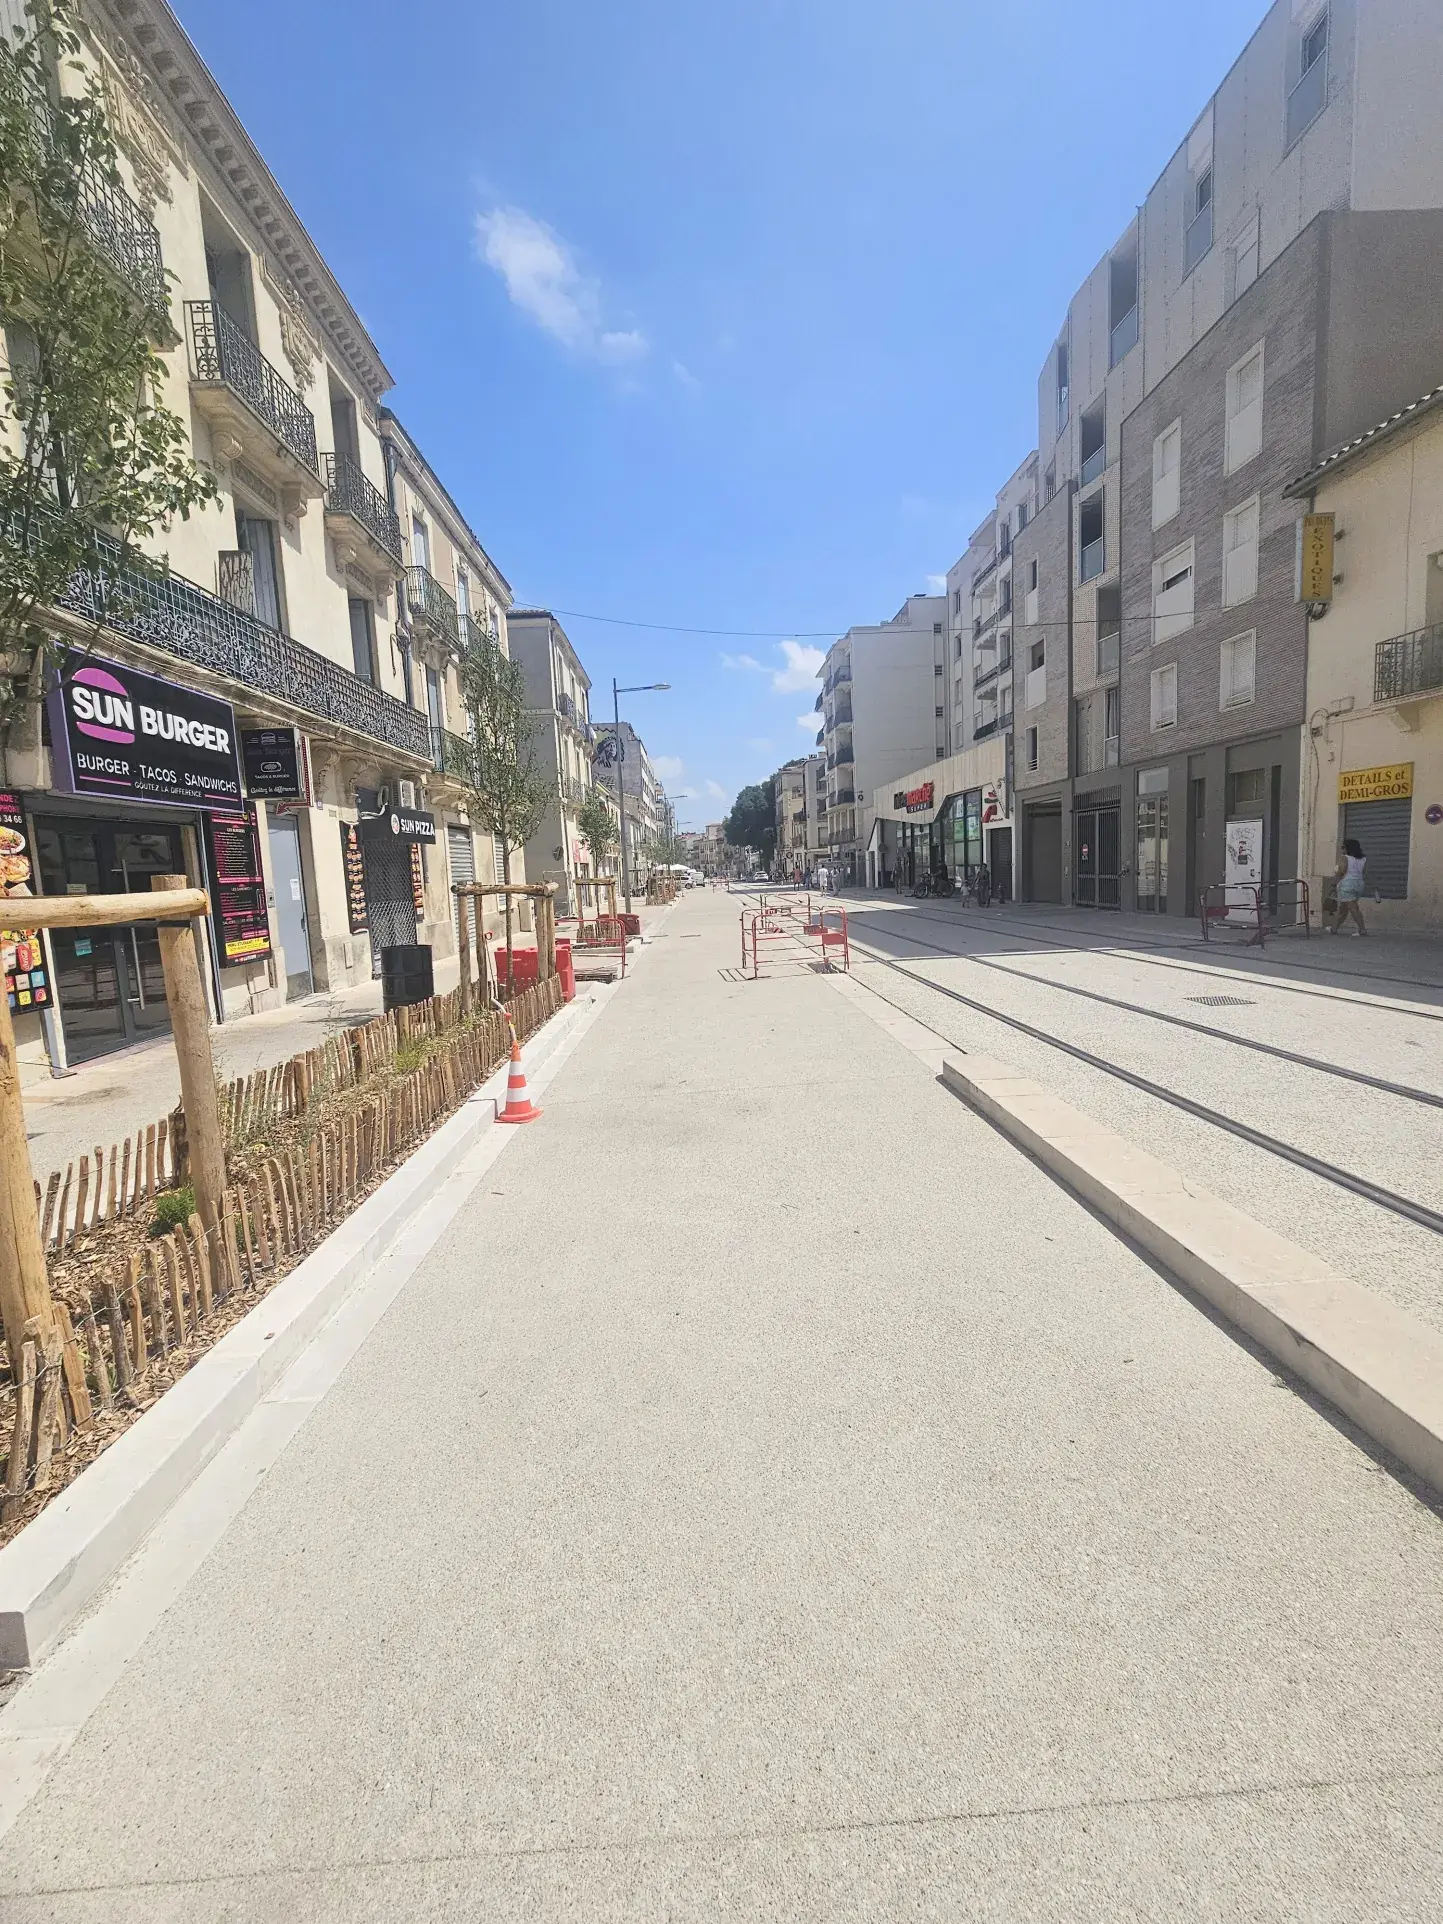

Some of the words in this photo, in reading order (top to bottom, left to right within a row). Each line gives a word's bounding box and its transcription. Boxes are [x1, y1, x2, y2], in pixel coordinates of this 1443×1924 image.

[1311, 528, 1324, 597] EXOTIQUES
[72, 686, 135, 730] SUN
[140, 705, 231, 754] BURGER
[77, 752, 130, 776] BURGER
[139, 764, 177, 784] TACOS
[185, 772, 237, 793] SANDWICHS
[1343, 771, 1391, 787] DETAILS
[1395, 770, 1405, 780] et
[161, 784, 169, 793] LA
[1340, 782, 1409, 800] DEMI-GROS
[401, 818, 414, 832] SUN
[415, 820, 435, 836] PIZZA
